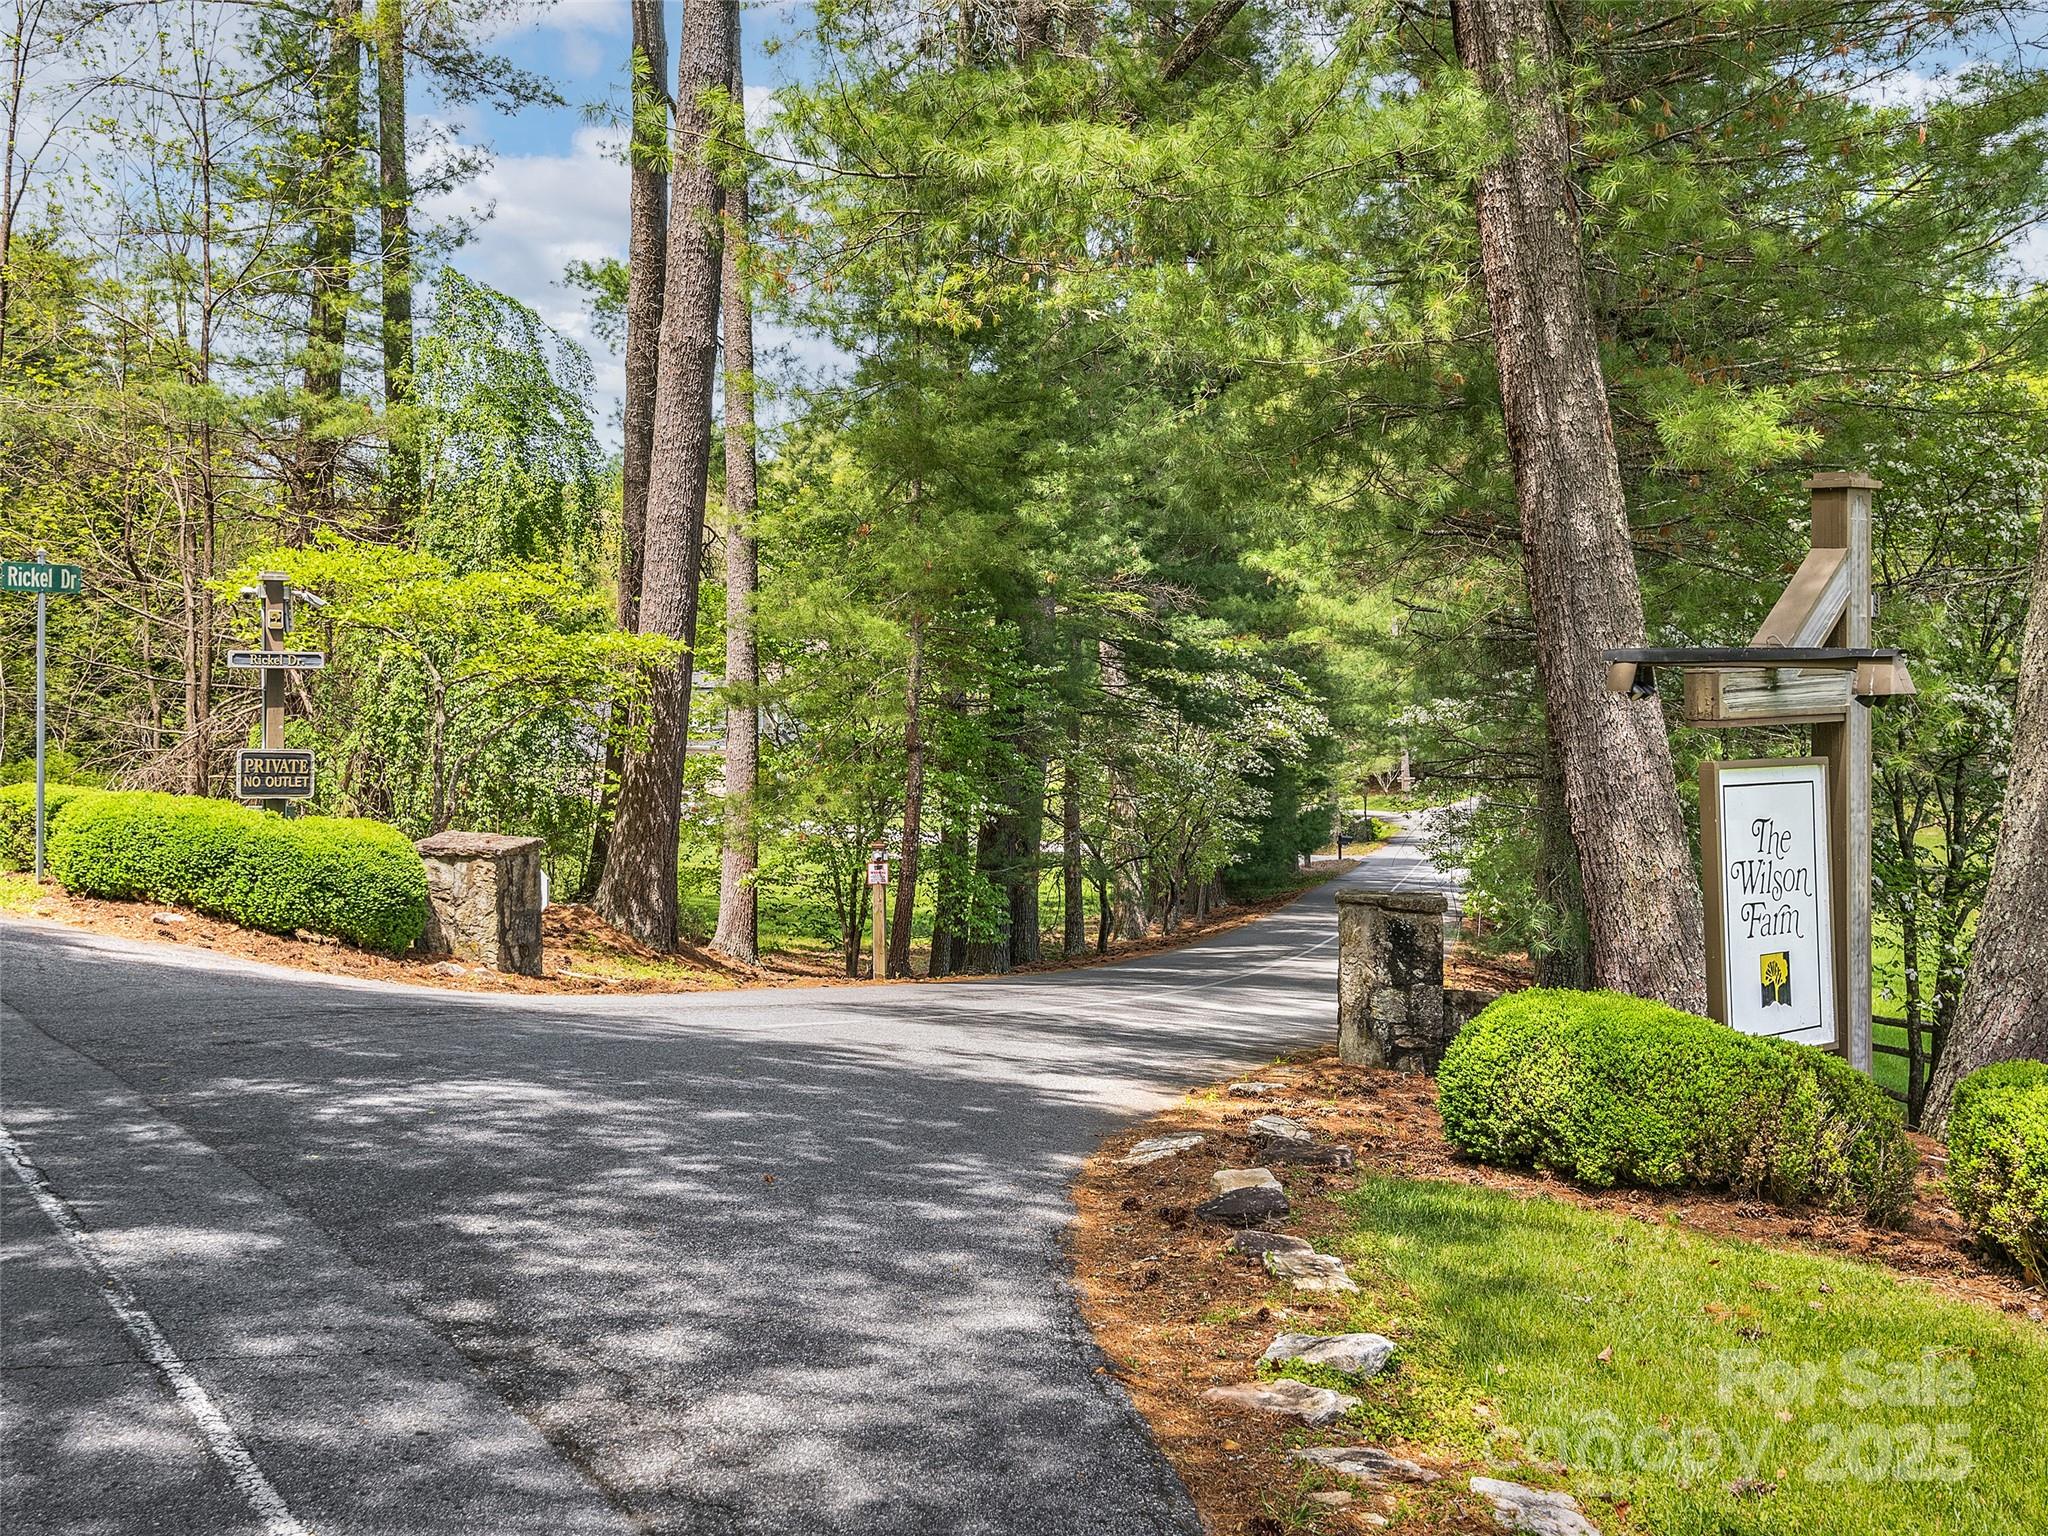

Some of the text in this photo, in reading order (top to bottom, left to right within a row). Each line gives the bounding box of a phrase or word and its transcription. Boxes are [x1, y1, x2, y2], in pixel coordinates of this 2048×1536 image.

[8, 566, 77, 589] Rickel Dr
[250, 655, 305, 665] Rickel Dr.
[244, 759, 309, 773] PRIVATE
[243, 776, 309, 787] NO OUTLET
[1752, 817, 1791, 859] The
[1731, 859, 1812, 901] Wilson
[1741, 902, 1804, 939] Farm
